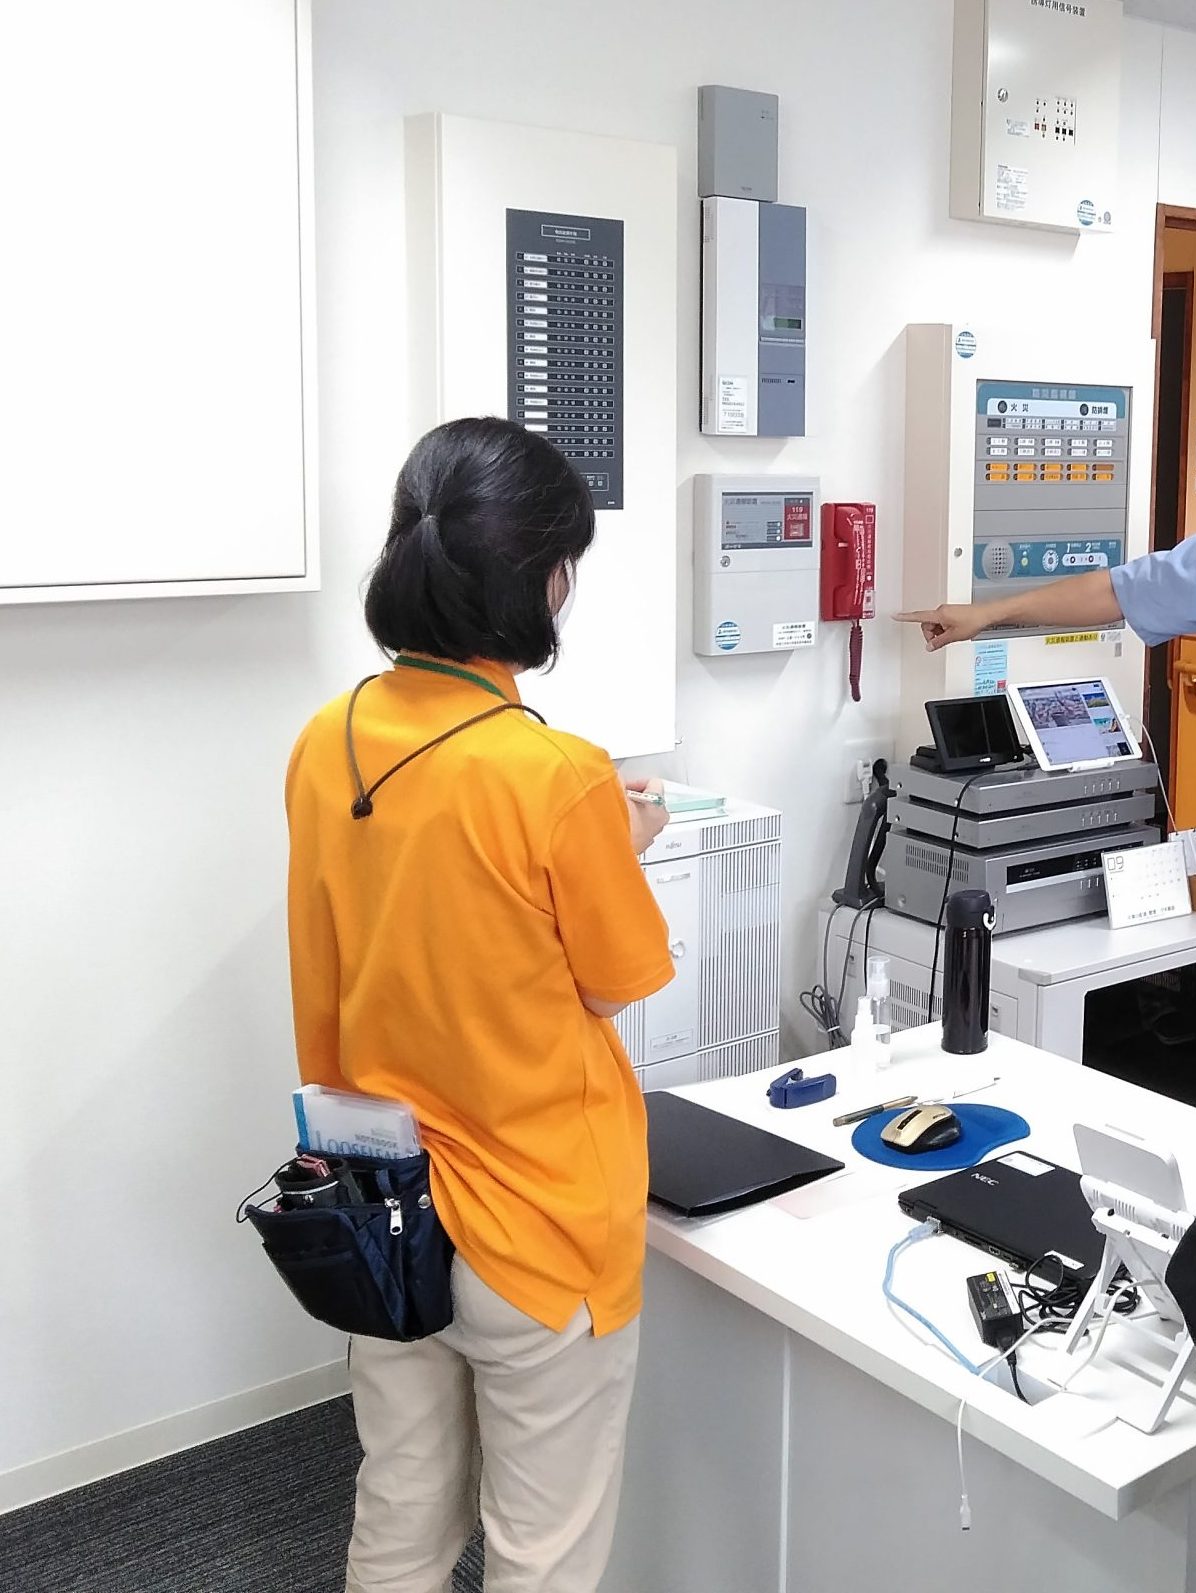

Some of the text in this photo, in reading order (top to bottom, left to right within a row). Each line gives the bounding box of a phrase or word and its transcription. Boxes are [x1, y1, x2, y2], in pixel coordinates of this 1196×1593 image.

[1085, 542, 1092, 553] 2
[1107, 855, 1124, 871] 09
[970, 1172, 1000, 1186] NEC
